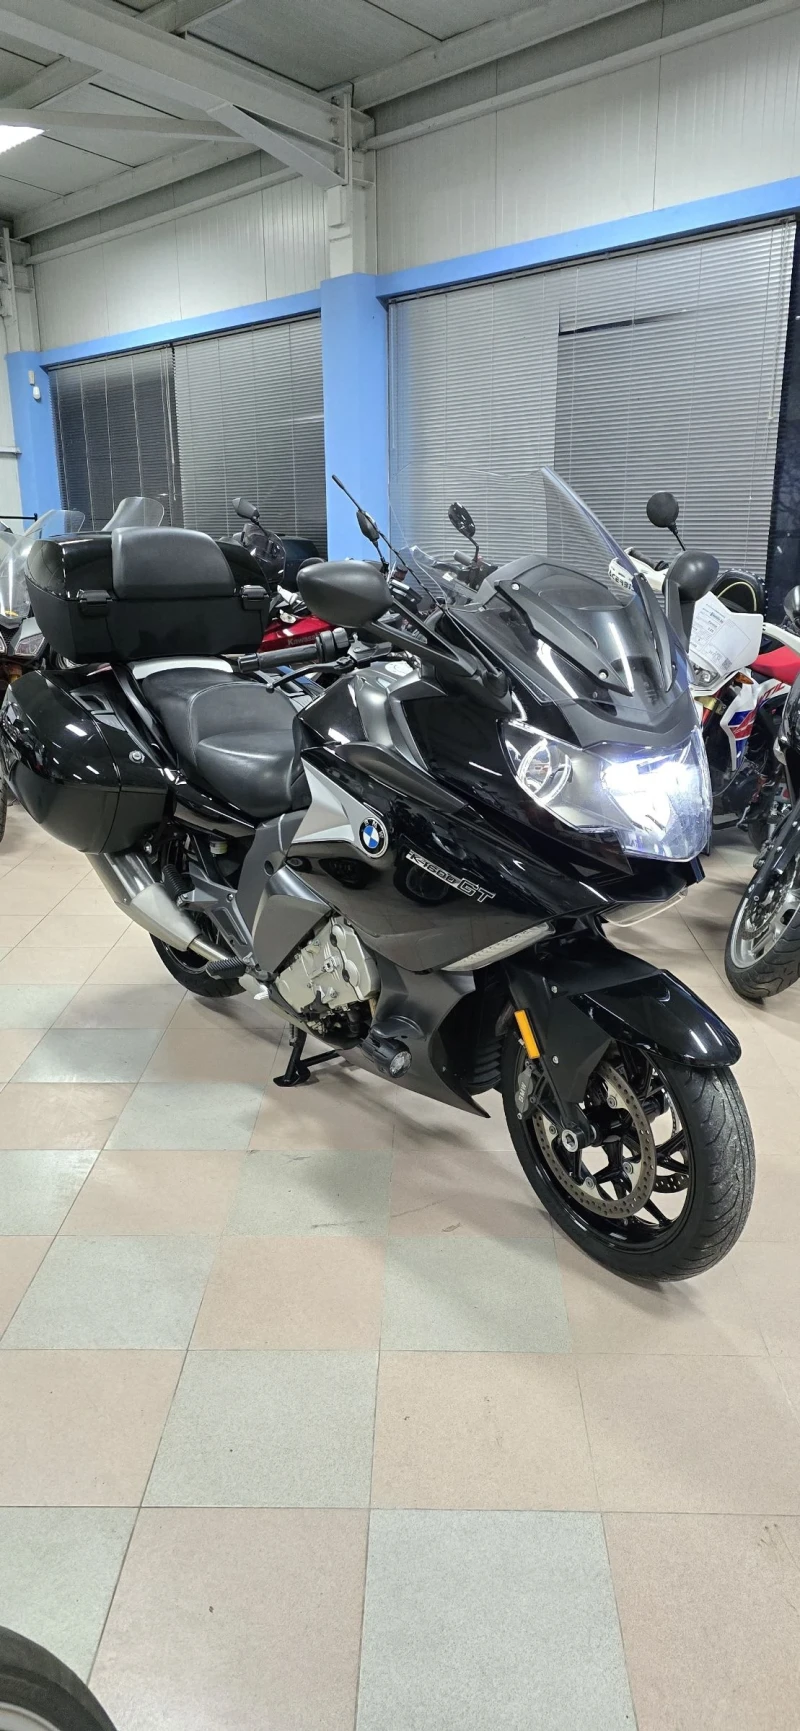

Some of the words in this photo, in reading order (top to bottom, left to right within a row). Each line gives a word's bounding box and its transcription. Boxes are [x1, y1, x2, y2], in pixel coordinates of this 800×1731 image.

[609, 570, 634, 590] ACERBI
[287, 633, 320, 646] Kawasa
[457, 877, 496, 903] GT
[518, 1081, 527, 1103] BMW
